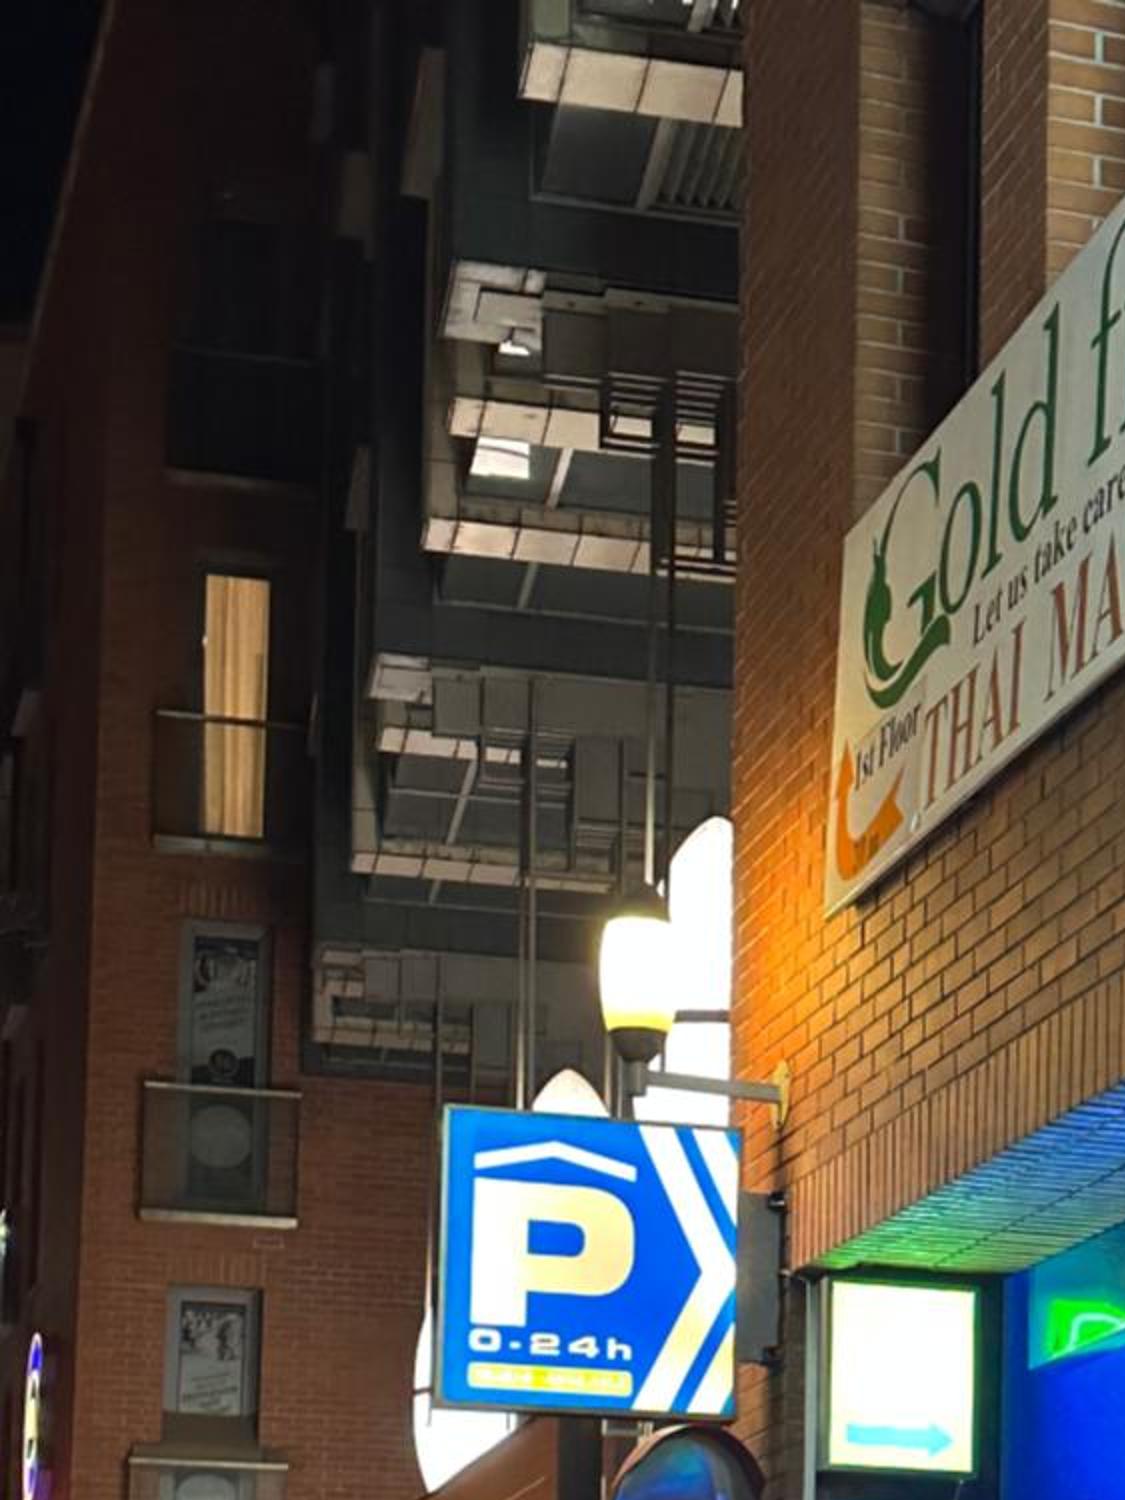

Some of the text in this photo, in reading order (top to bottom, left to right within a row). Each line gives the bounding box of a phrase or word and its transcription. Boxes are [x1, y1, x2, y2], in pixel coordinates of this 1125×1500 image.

[863, 301, 1060, 709] Gold
[973, 590, 1003, 647] Let
[1007, 565, 1028, 611] us
[1034, 516, 1078, 585] take
[879, 703, 921, 768] Floor
[924, 615, 1026, 810] THAI
[470, 1176, 636, 1328] P
